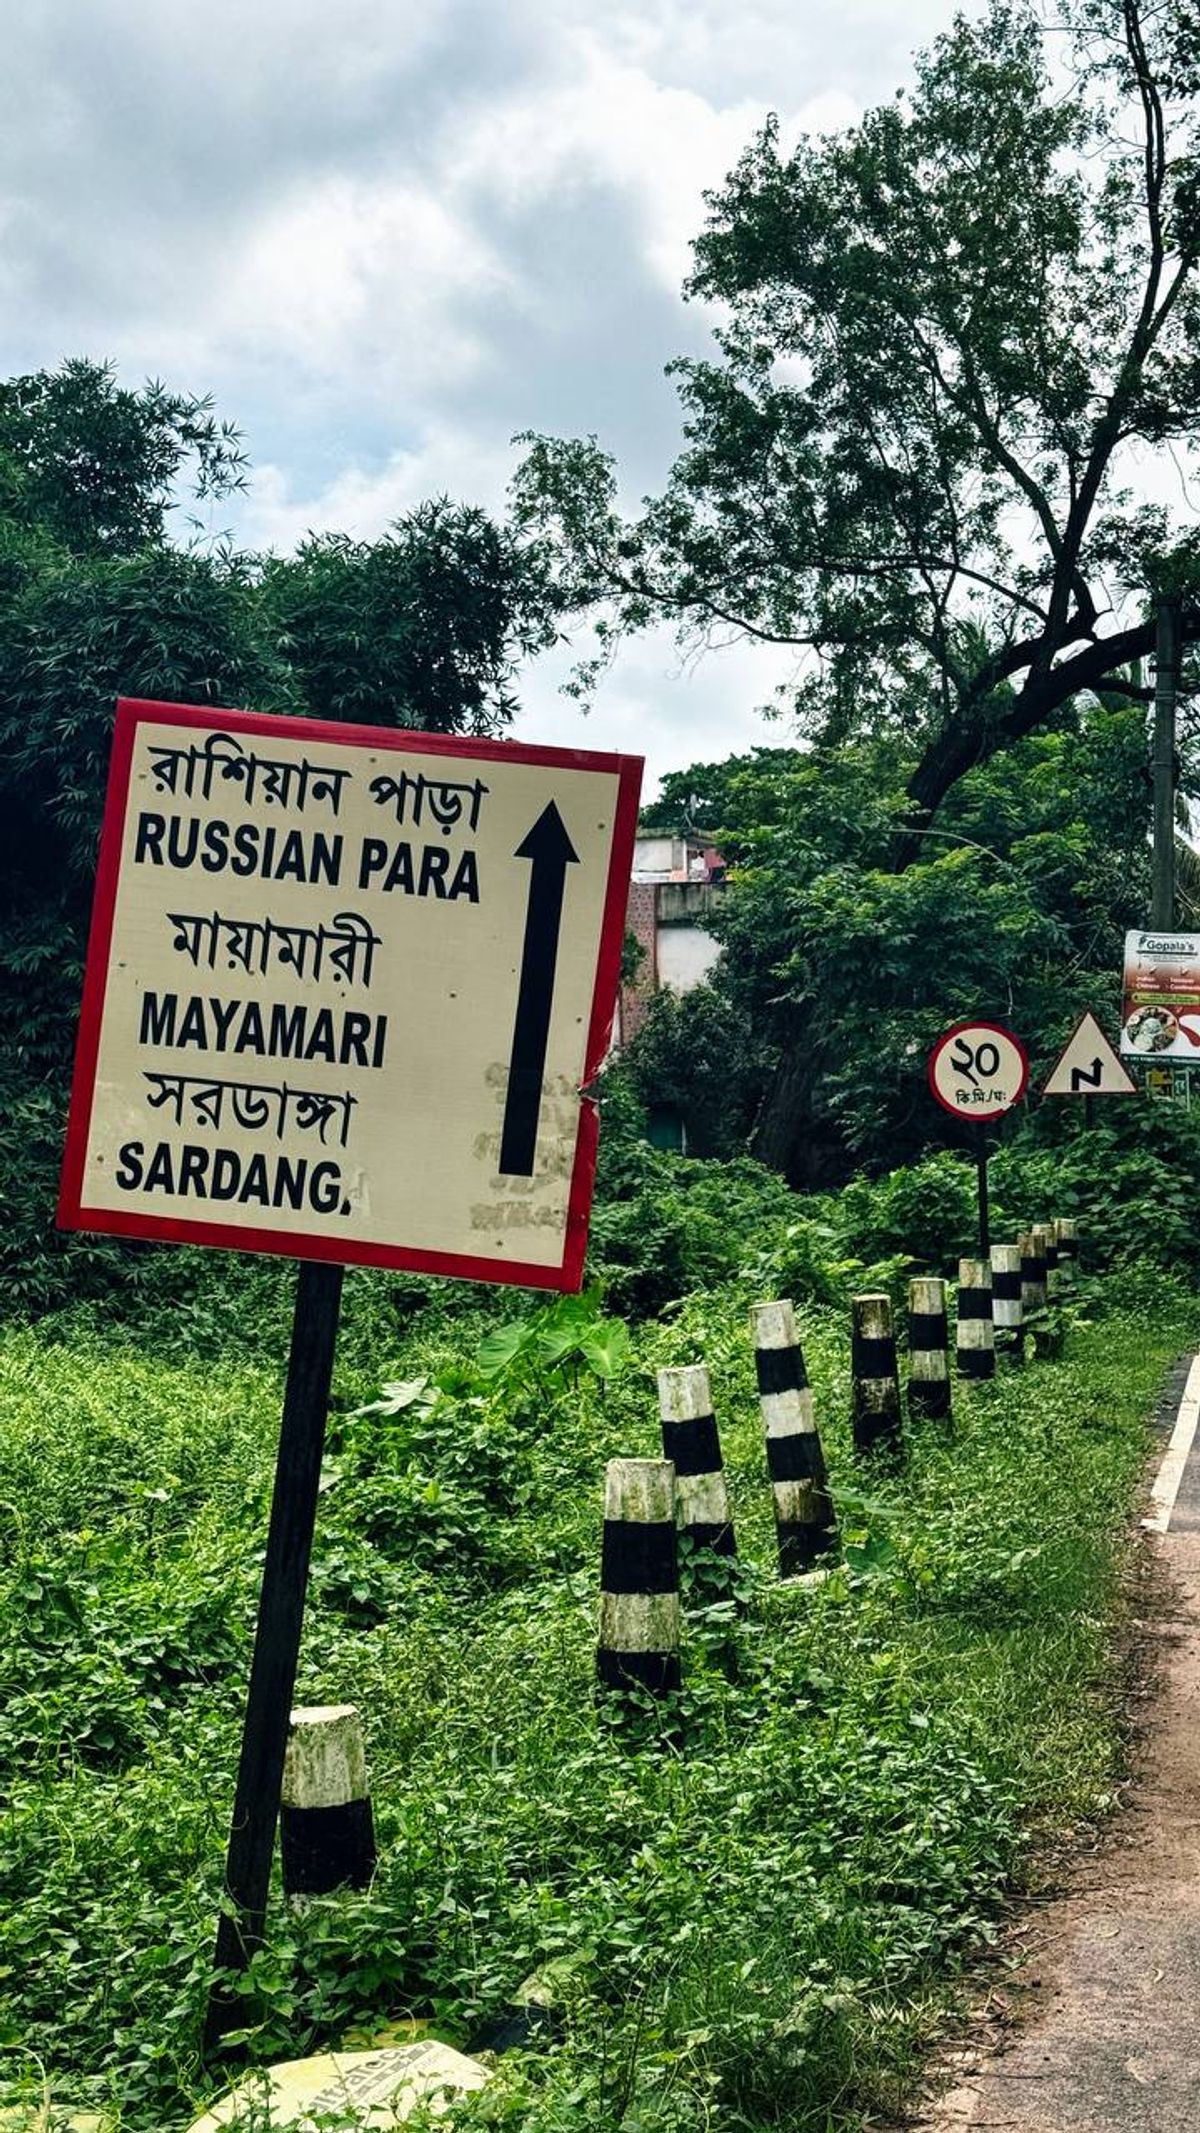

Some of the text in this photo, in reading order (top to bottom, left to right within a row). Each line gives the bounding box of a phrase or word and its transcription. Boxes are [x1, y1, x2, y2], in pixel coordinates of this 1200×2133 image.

[148, 733, 490, 835] রাশিয়ান পাড়া
[135, 812, 480, 904] RUSSIAN PARA
[167, 910, 383, 988] মায়ামারী
[1146, 940, 1195, 951] Gopala's
[140, 992, 388, 1068] MAYAMARI
[950, 1038, 1001, 1087] ২০
[143, 1071, 359, 1148] সরডাঙ্গা
[116, 1141, 352, 1216] SARDANG
